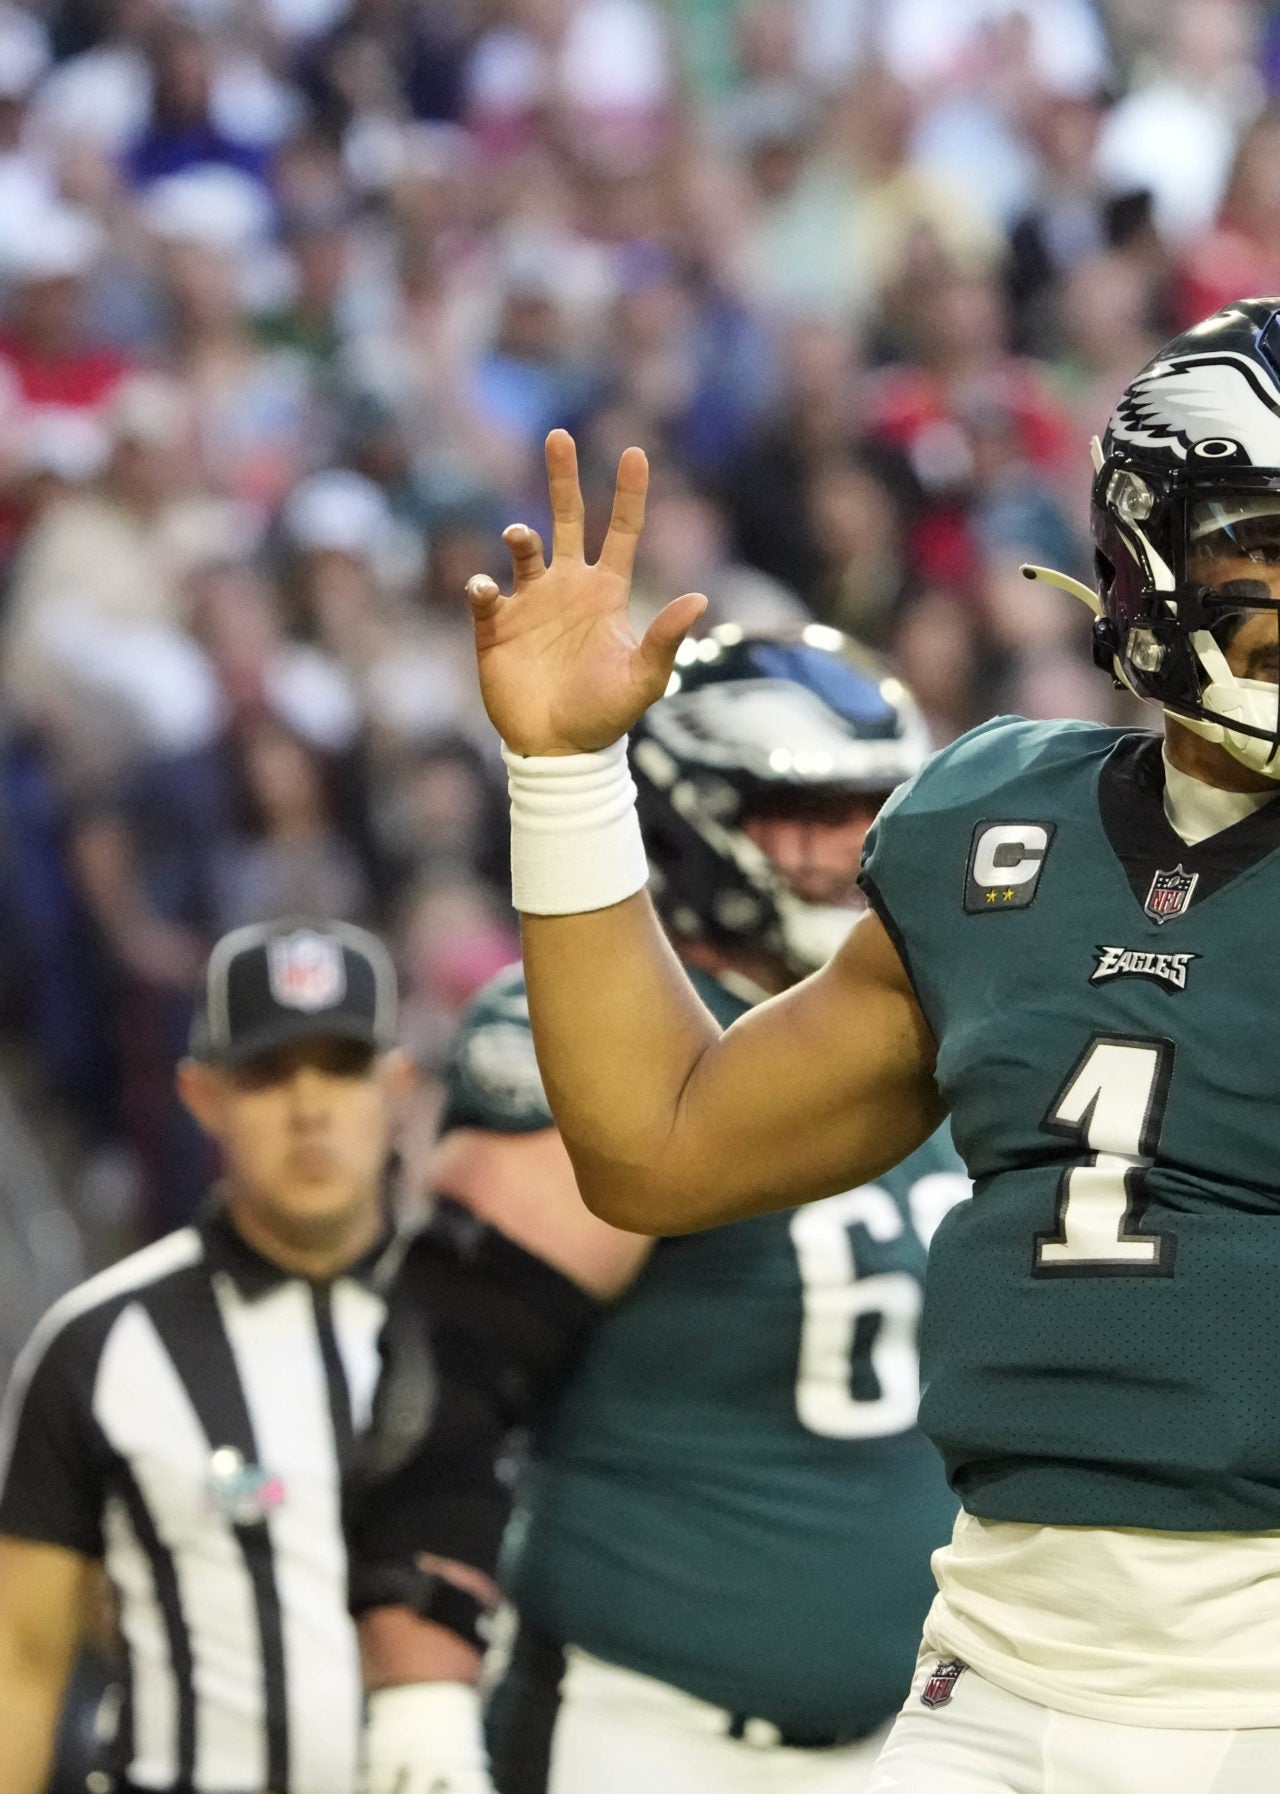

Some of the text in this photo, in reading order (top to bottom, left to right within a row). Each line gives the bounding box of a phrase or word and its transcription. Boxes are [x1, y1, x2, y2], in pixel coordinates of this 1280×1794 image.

[973, 824, 1049, 887] C
[1151, 889, 1182, 913] NFL
[1091, 945, 1197, 989] EAGLES
[1035, 1036, 1171, 1272] 1
[925, 1678, 953, 1700] NFL
